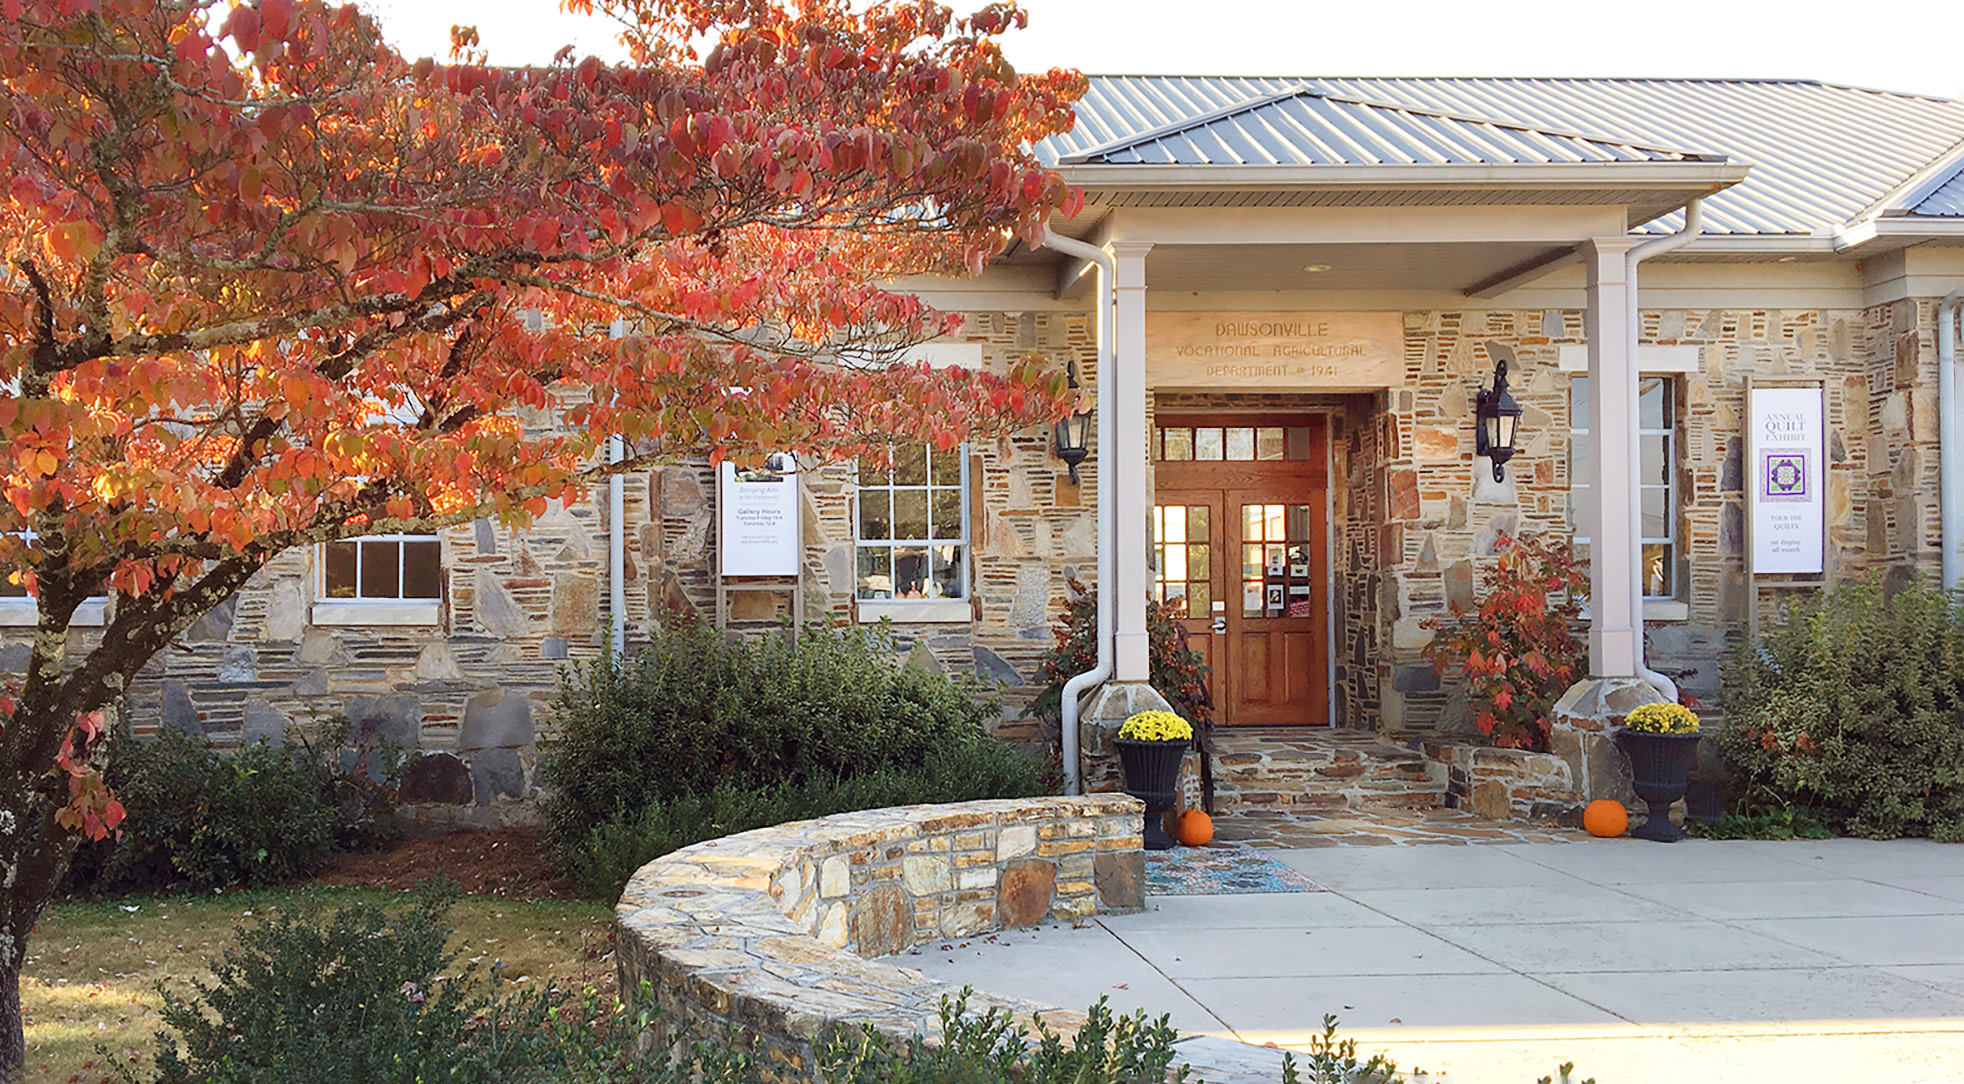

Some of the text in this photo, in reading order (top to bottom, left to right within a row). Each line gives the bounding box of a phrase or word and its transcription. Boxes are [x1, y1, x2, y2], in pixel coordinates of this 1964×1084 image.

[1216, 322, 1328, 337] DAWSONVILLE
[1176, 345, 1367, 357] VOCATIONAL AGRICULTURAL
[1207, 365, 1337, 376] DEPARTMENT 1941
[1765, 413, 1806, 421] ANNUAL
[1765, 421, 1806, 433] QUILT
[1773, 523, 1799, 531] QUILTS
